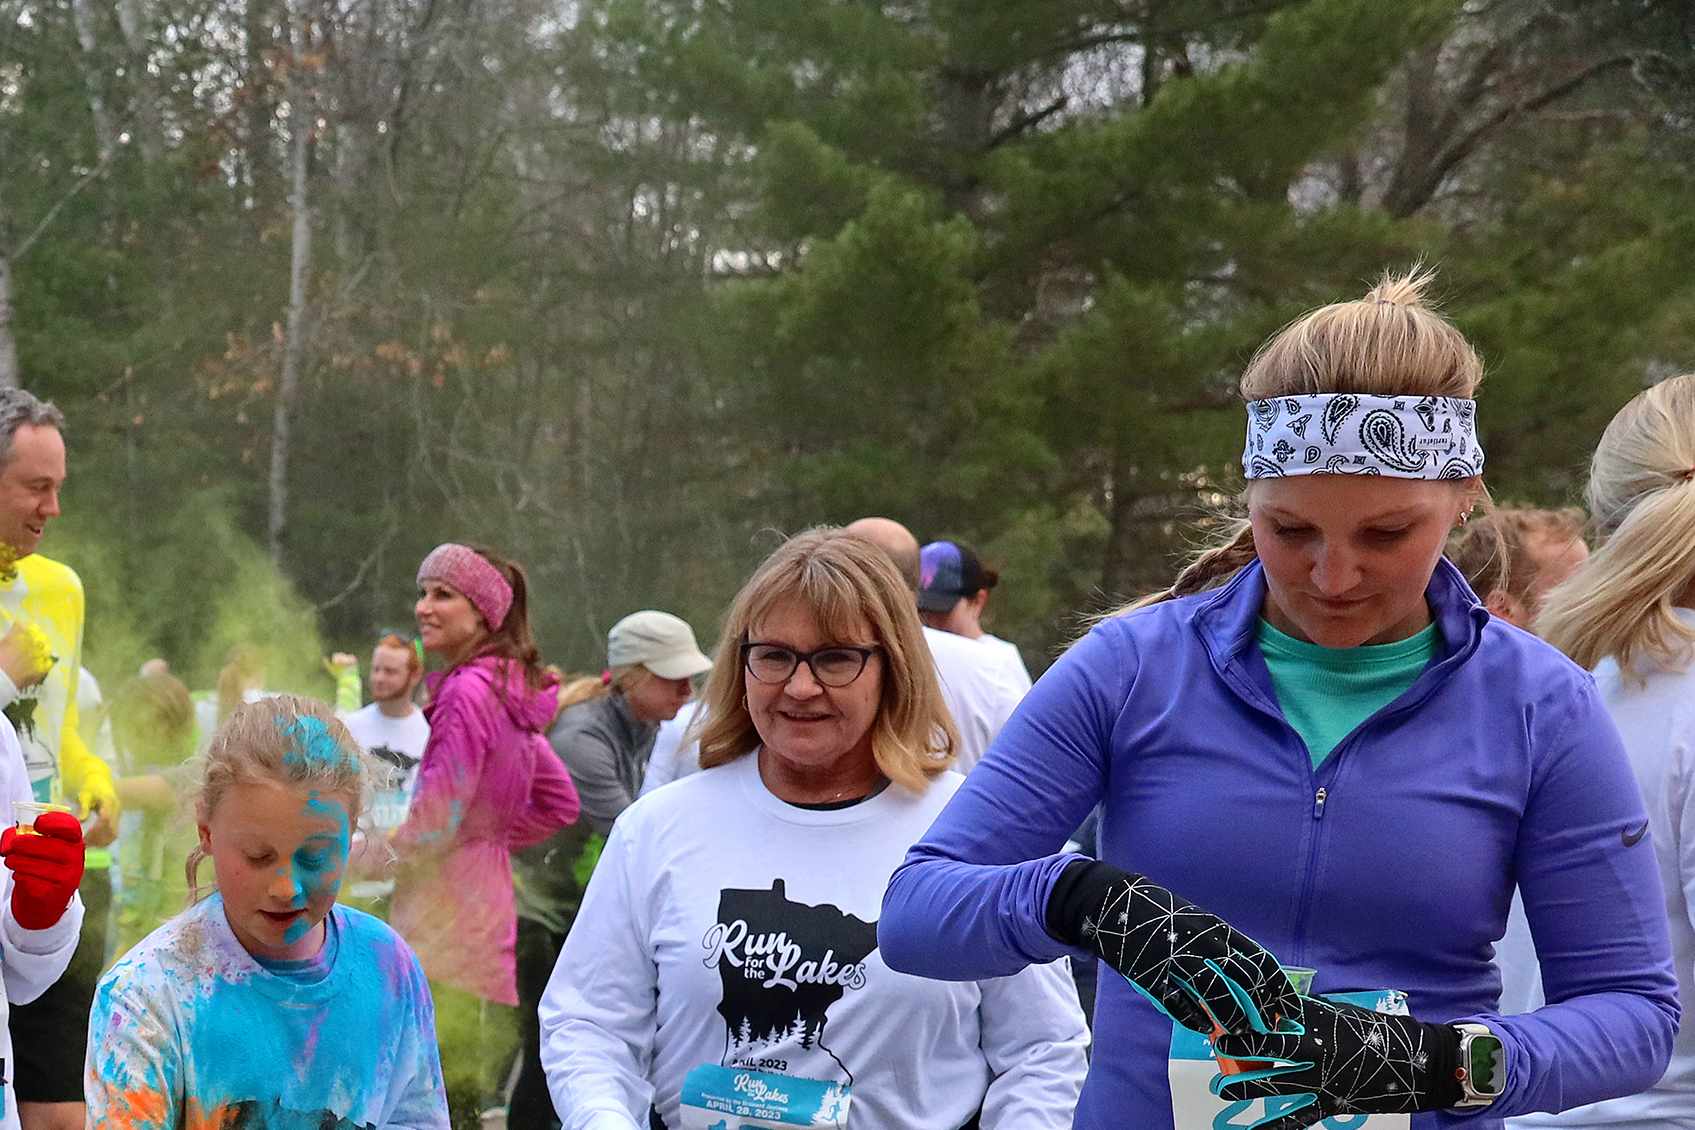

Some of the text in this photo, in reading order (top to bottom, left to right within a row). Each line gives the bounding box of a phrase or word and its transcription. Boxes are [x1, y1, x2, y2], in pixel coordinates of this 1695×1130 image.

[702, 919, 792, 969] Run
[744, 955, 765, 970] for
[763, 942, 868, 993] Lakes
[744, 967, 766, 981] the
[758, 1059, 788, 1071] 2023
[734, 1073, 763, 1092] Run
[753, 1083, 789, 1104] Lakes
[706, 1099, 734, 1113] APRIL
[755, 1108, 782, 1120] 2023
